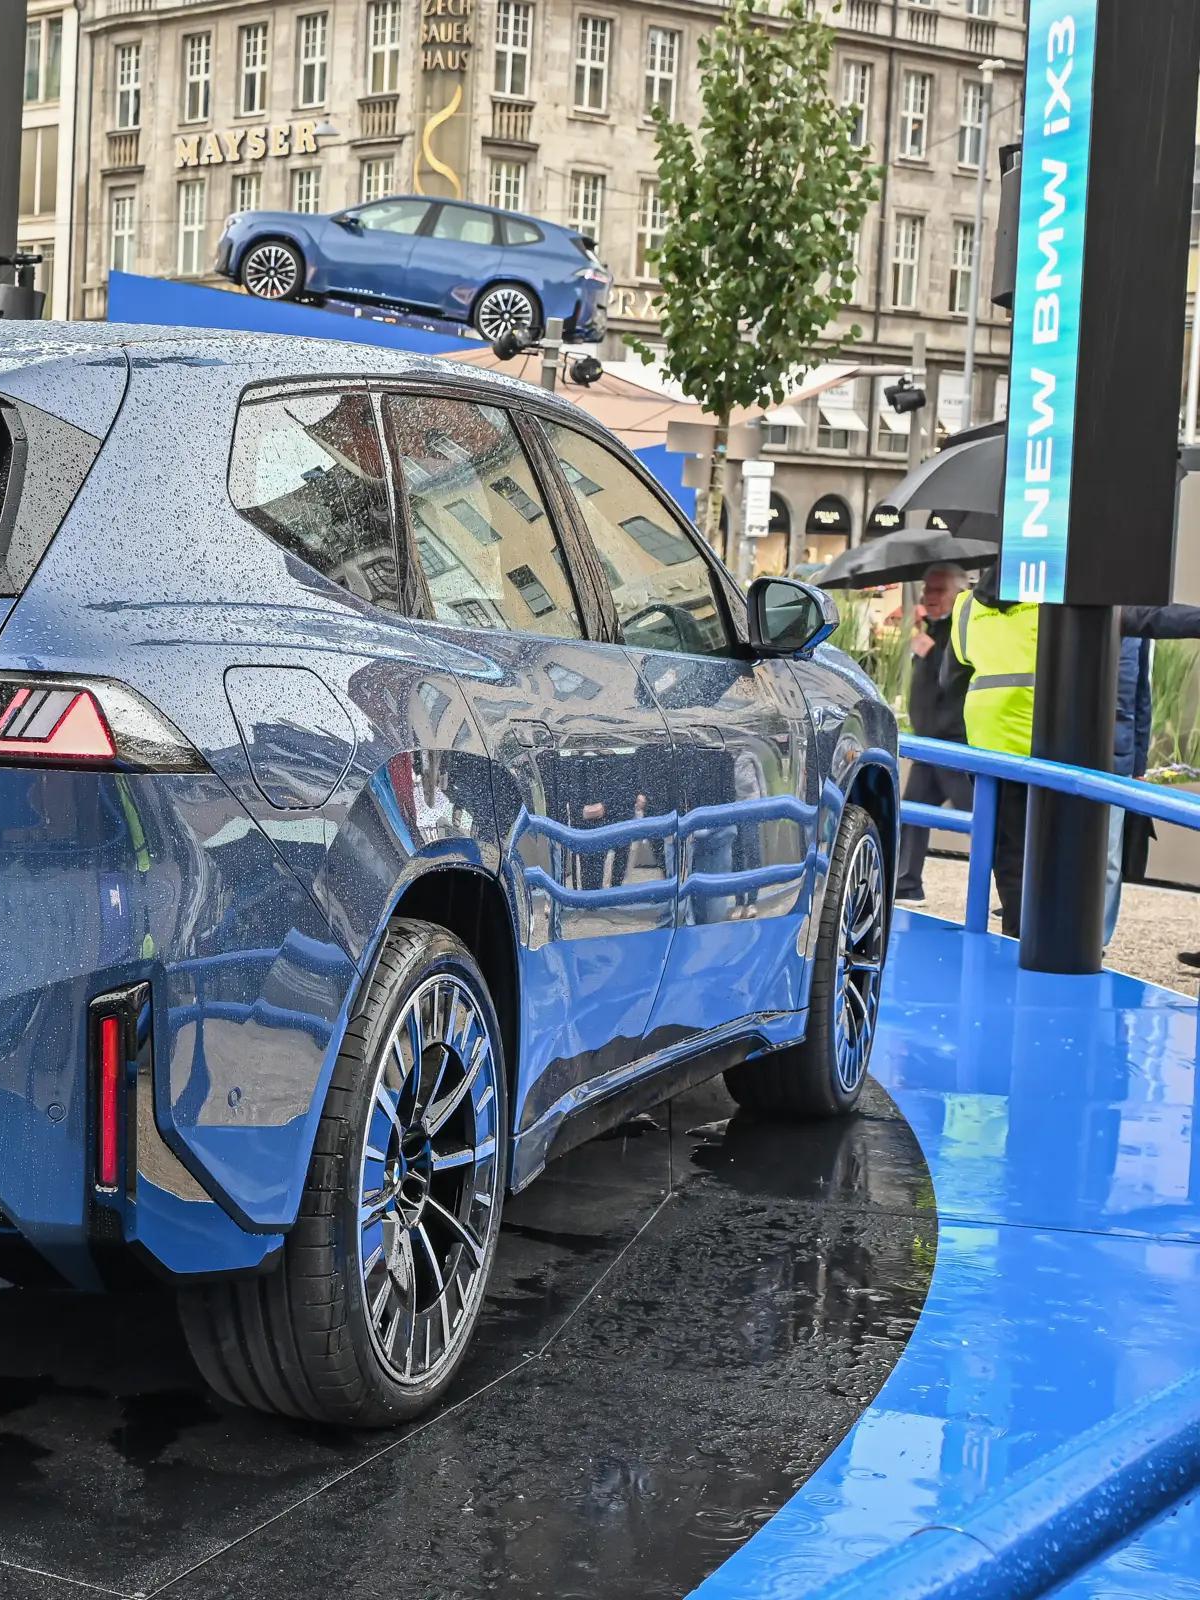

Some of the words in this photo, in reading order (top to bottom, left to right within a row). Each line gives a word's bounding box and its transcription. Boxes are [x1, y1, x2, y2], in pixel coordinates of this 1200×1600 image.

[422, 50, 468, 71] HAUS
[1043, 15, 1075, 136] iX3
[174, 120, 317, 168] MAYSER
[1032, 158, 1068, 345] BMW
[1022, 368, 1057, 538] NEW
